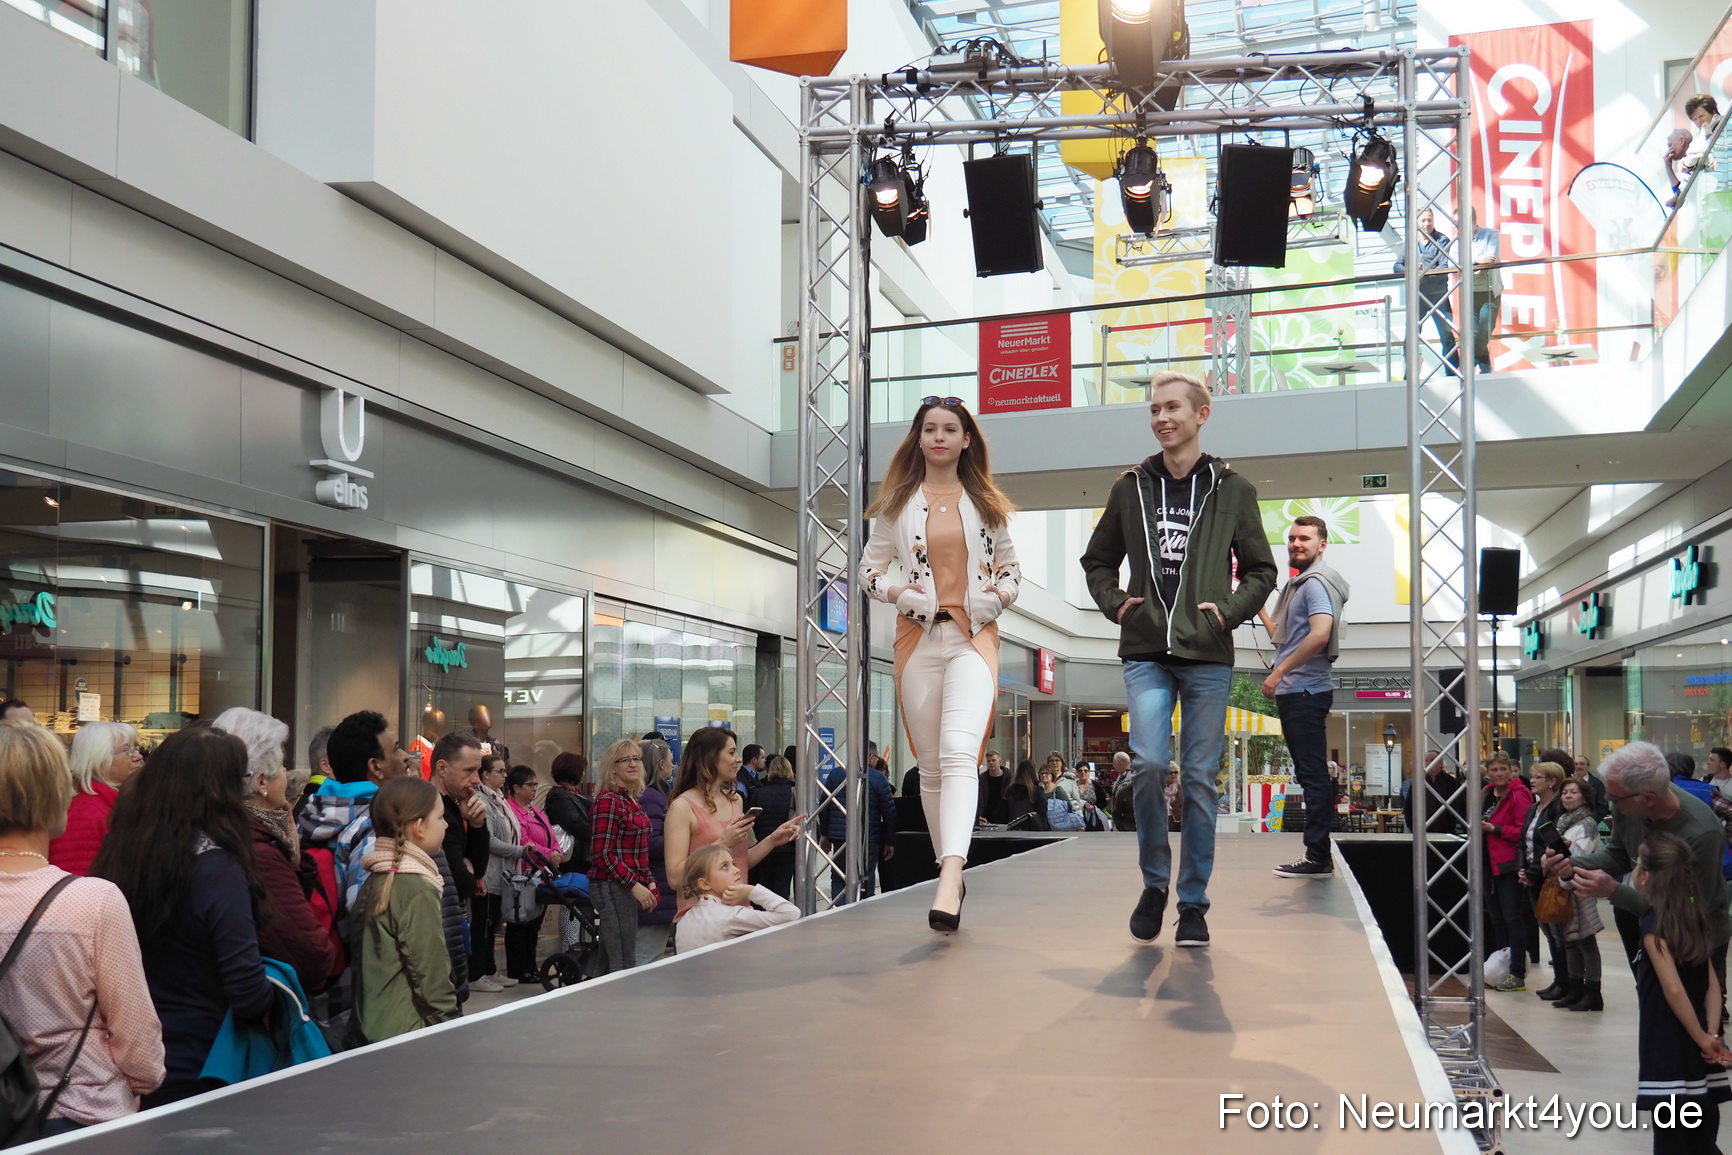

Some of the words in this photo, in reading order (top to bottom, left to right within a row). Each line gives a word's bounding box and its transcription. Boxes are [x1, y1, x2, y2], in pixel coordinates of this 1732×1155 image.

[1487, 63, 1551, 371] CINEPLEX
[998, 335, 1051, 348] NeuerMarkt
[989, 364, 1059, 384] CINEPLEX
